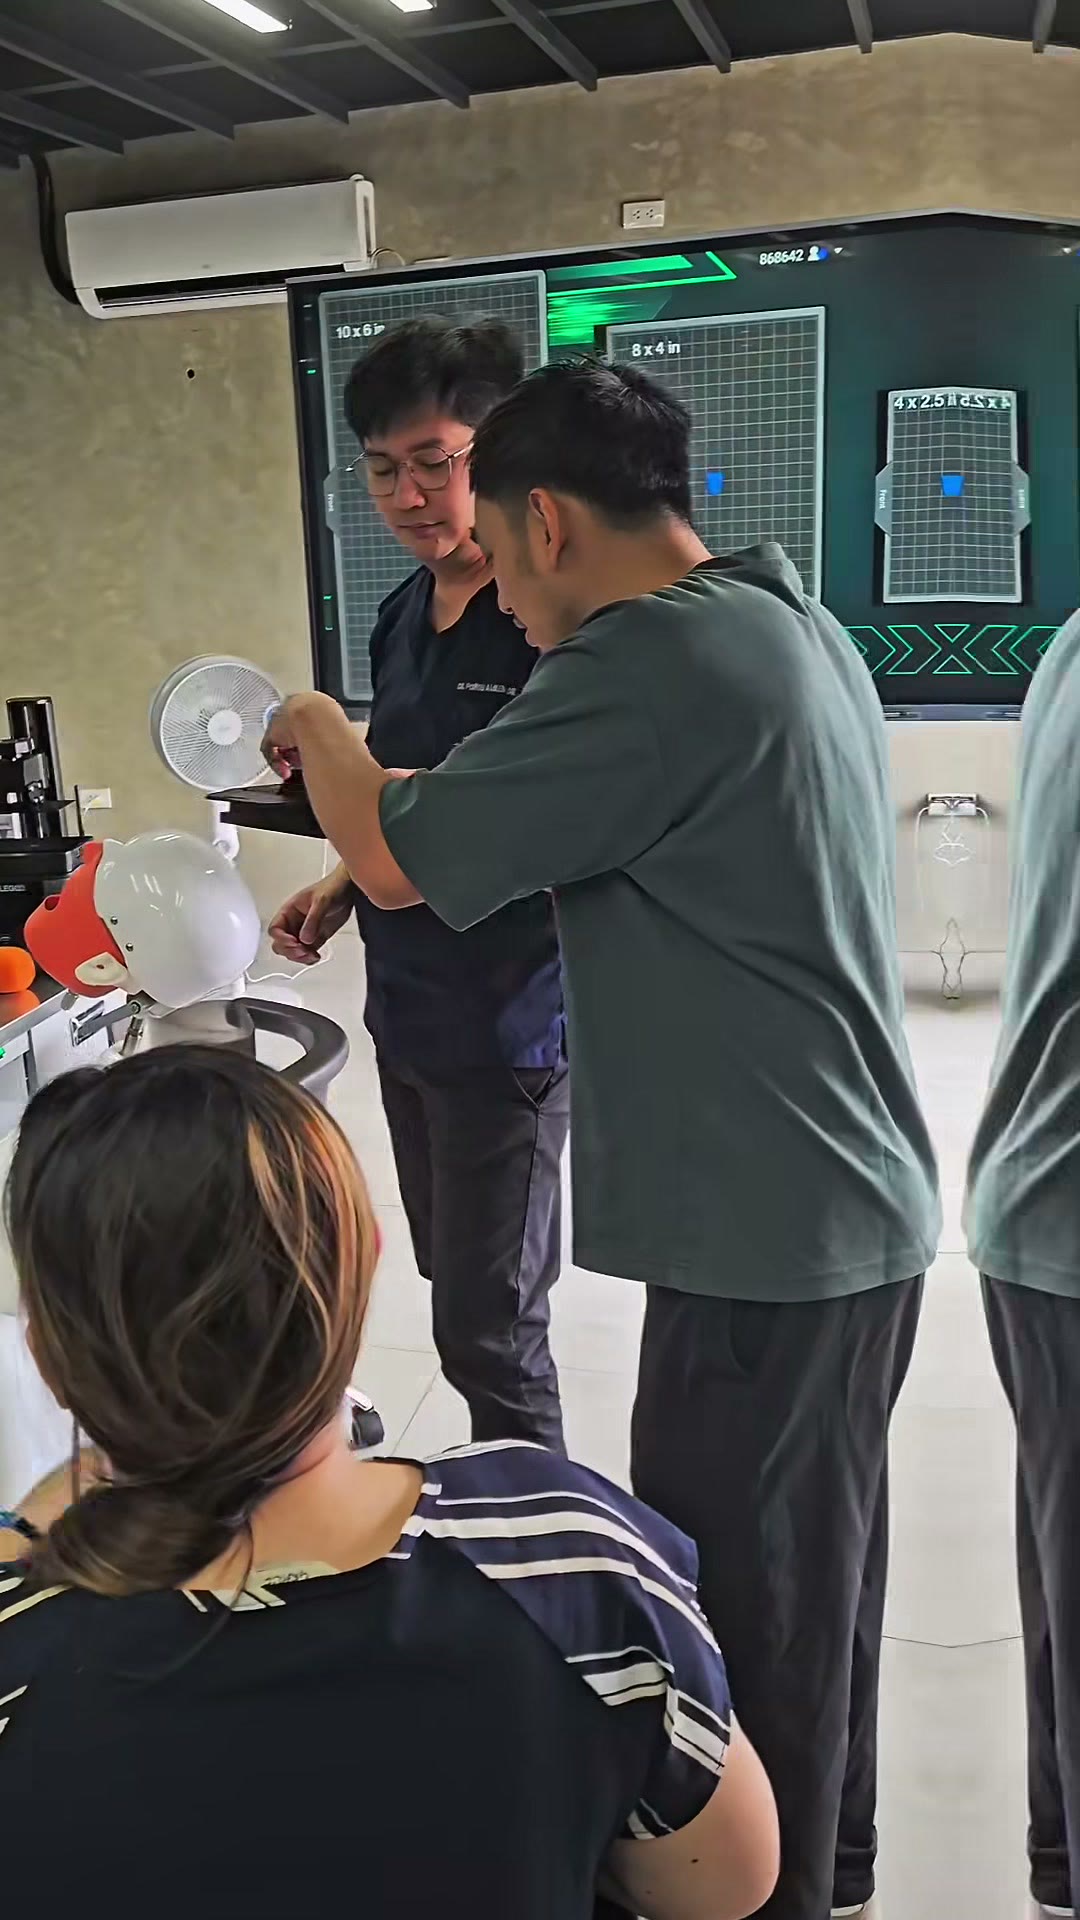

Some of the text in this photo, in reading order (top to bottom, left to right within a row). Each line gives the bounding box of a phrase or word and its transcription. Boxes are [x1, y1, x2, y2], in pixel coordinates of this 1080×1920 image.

[759, 248, 804, 265] 868642
[336, 325, 351, 339] 10
[352, 327, 361, 338] x
[363, 323, 372, 336] 6
[632, 340, 680, 357] 8 x 4 in
[894, 396, 904, 409] 4
[907, 398, 917, 409] x
[920, 394, 944, 408] 2.5
